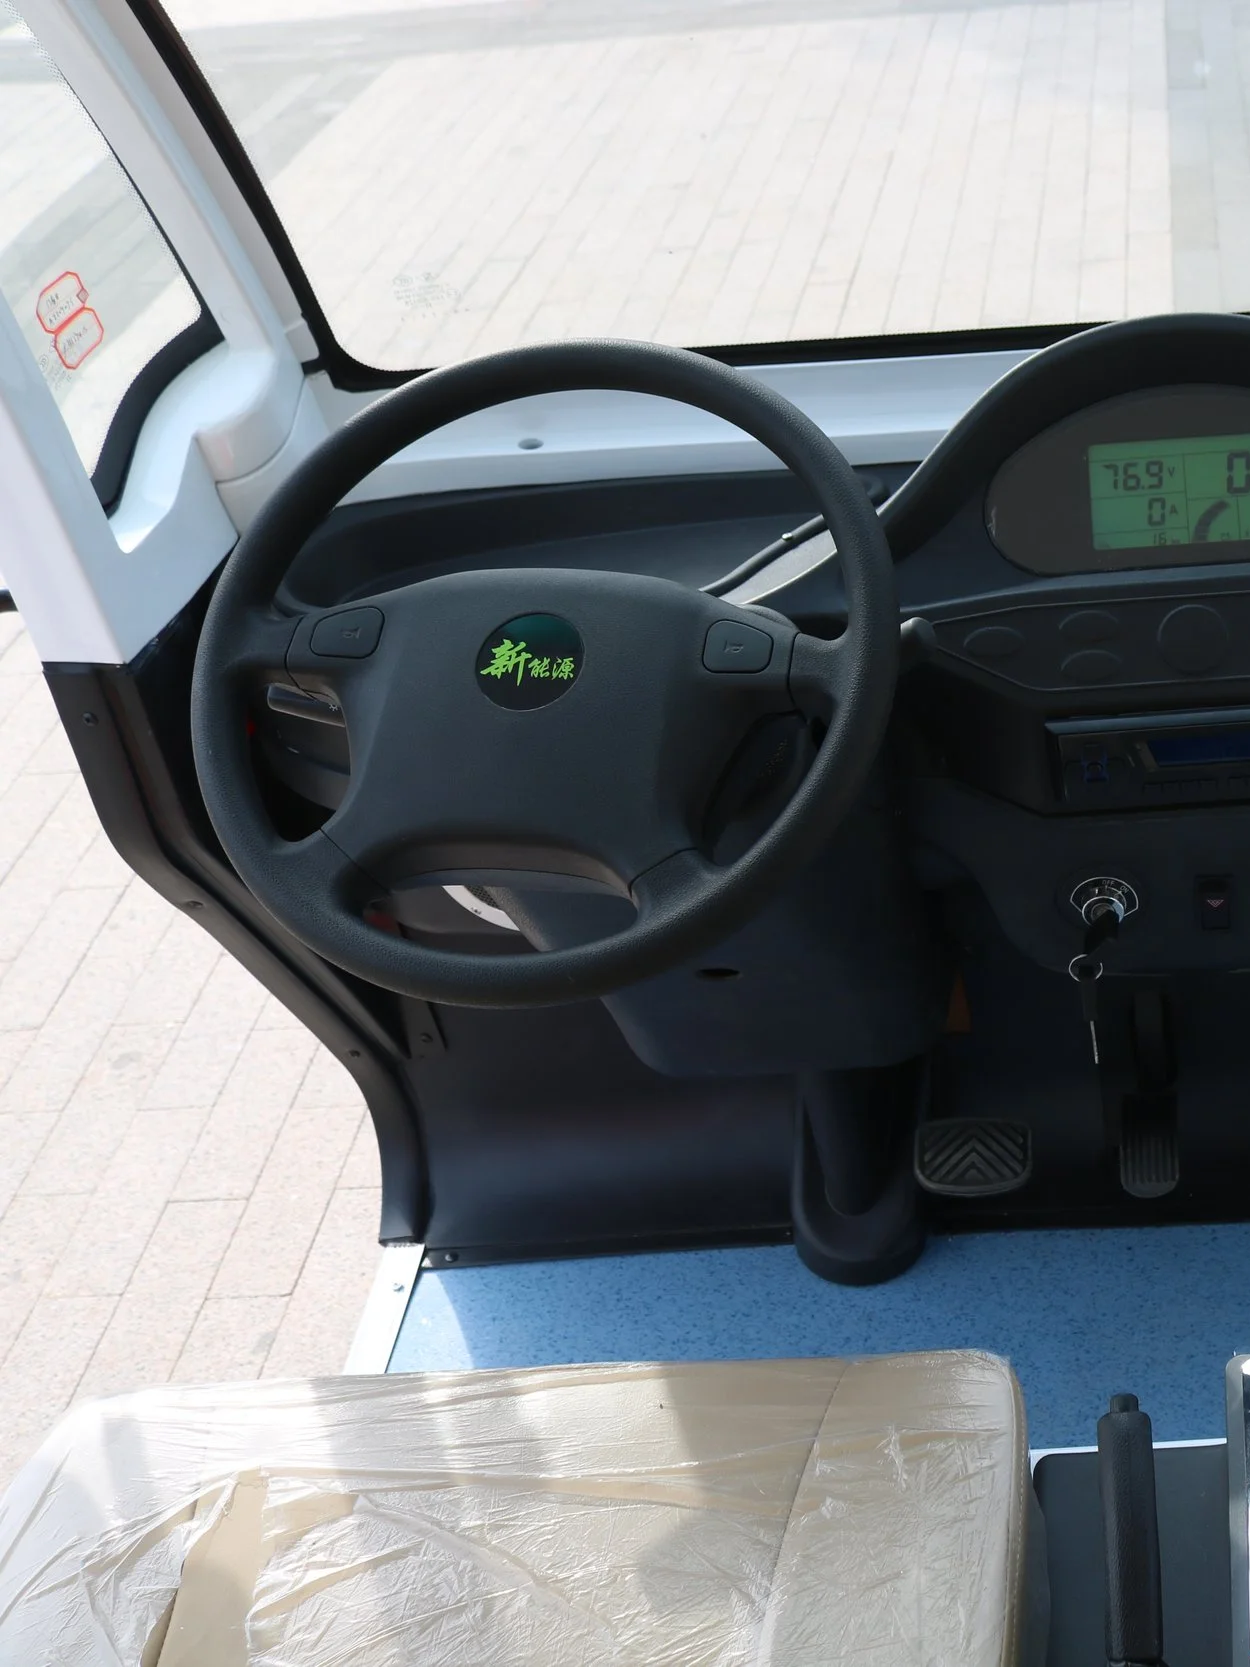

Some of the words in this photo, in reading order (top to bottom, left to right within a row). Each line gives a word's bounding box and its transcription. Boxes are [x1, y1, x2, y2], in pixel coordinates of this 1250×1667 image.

[1103, 460, 1164, 491] 76.9
[1167, 466, 1176, 478] V
[1147, 497, 1167, 527] 0
[1169, 504, 1179, 516] A
[480, 639, 576, 687] 新能源
[1101, 879, 1116, 887] OFF
[1119, 885, 1130, 894] ON
